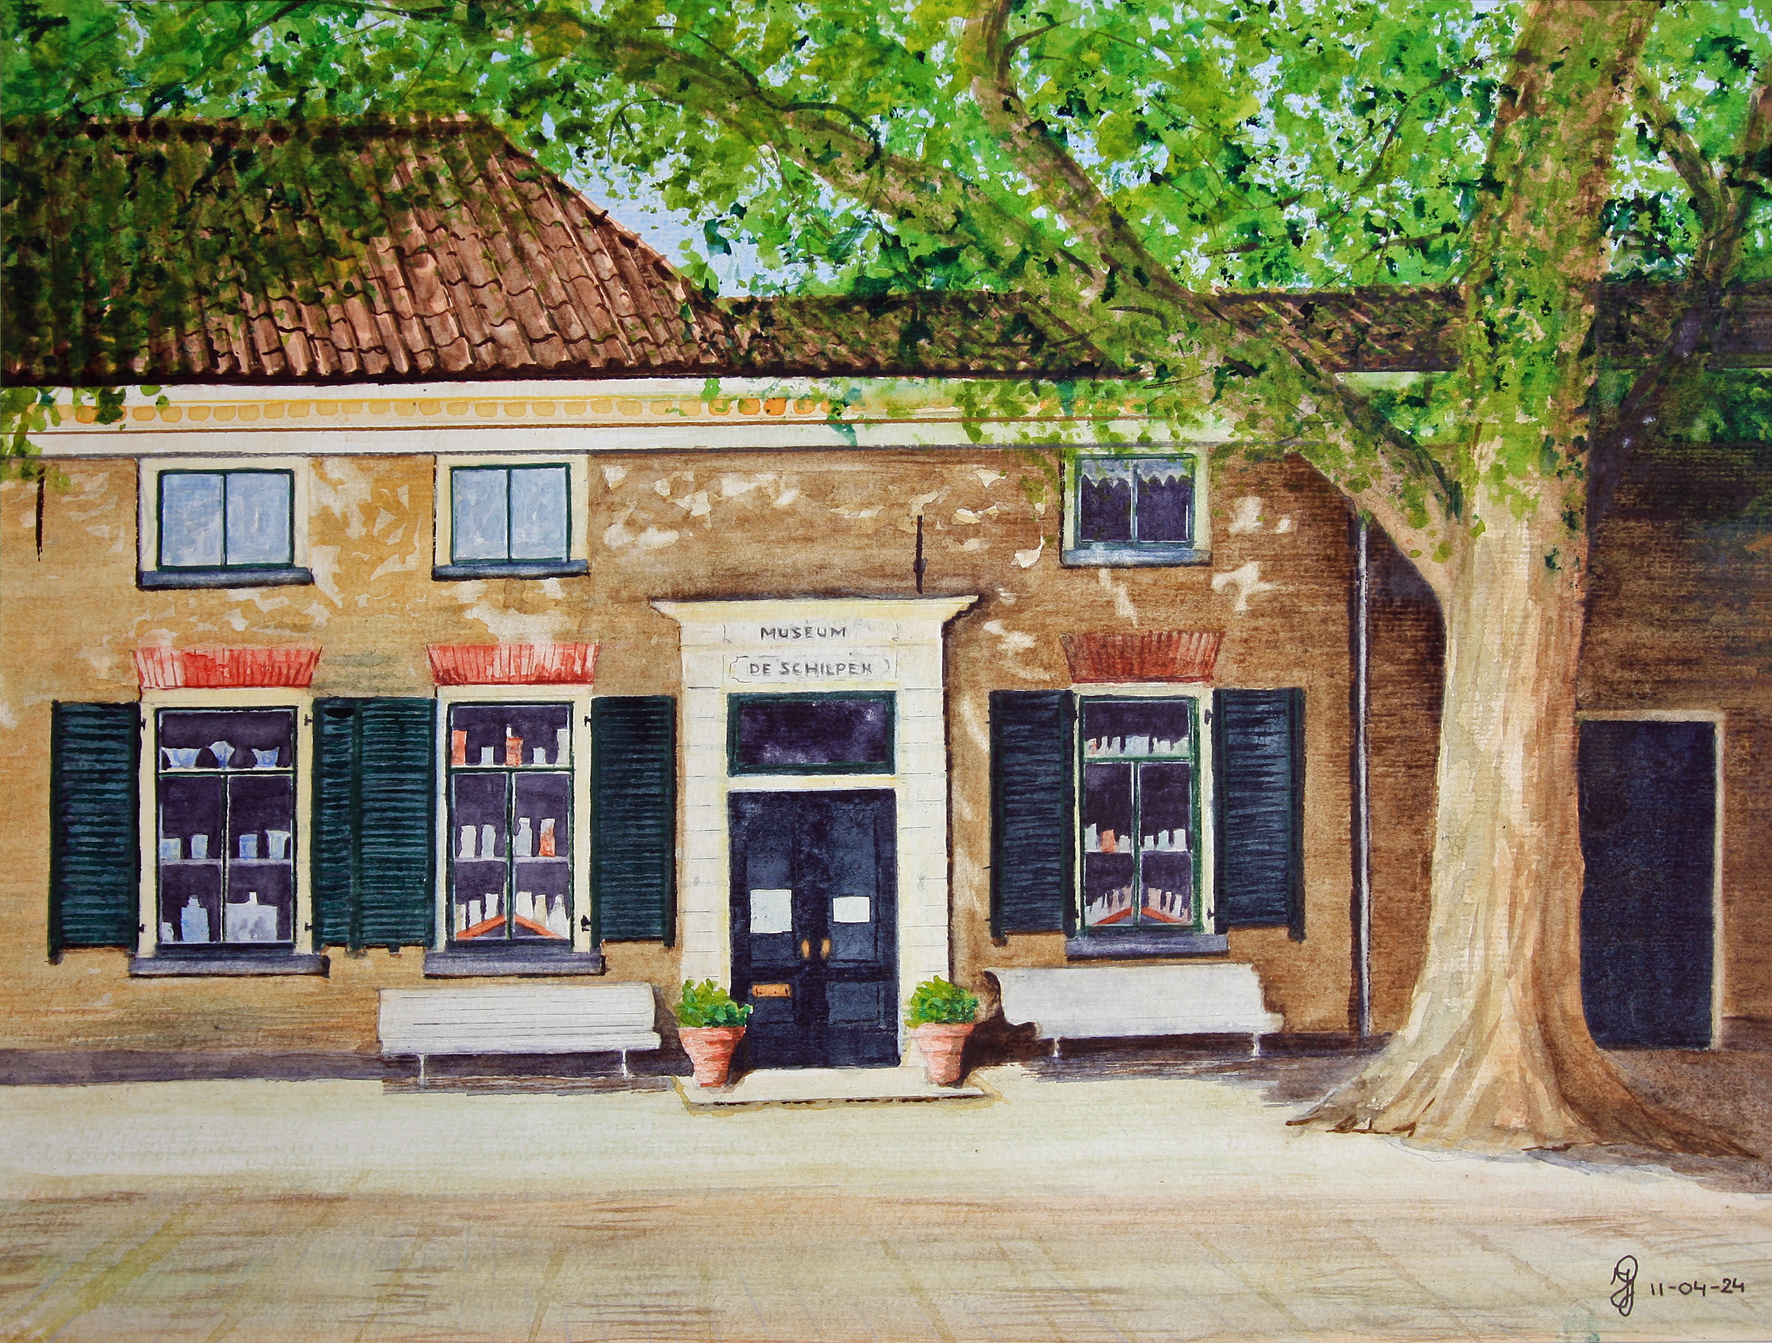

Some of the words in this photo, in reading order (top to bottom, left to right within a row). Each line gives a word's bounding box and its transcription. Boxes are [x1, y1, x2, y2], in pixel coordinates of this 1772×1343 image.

[760, 626, 846, 641] MUSEUM
[749, 662, 772, 676] DE
[1650, 1277, 1745, 1298] 11-04-24
